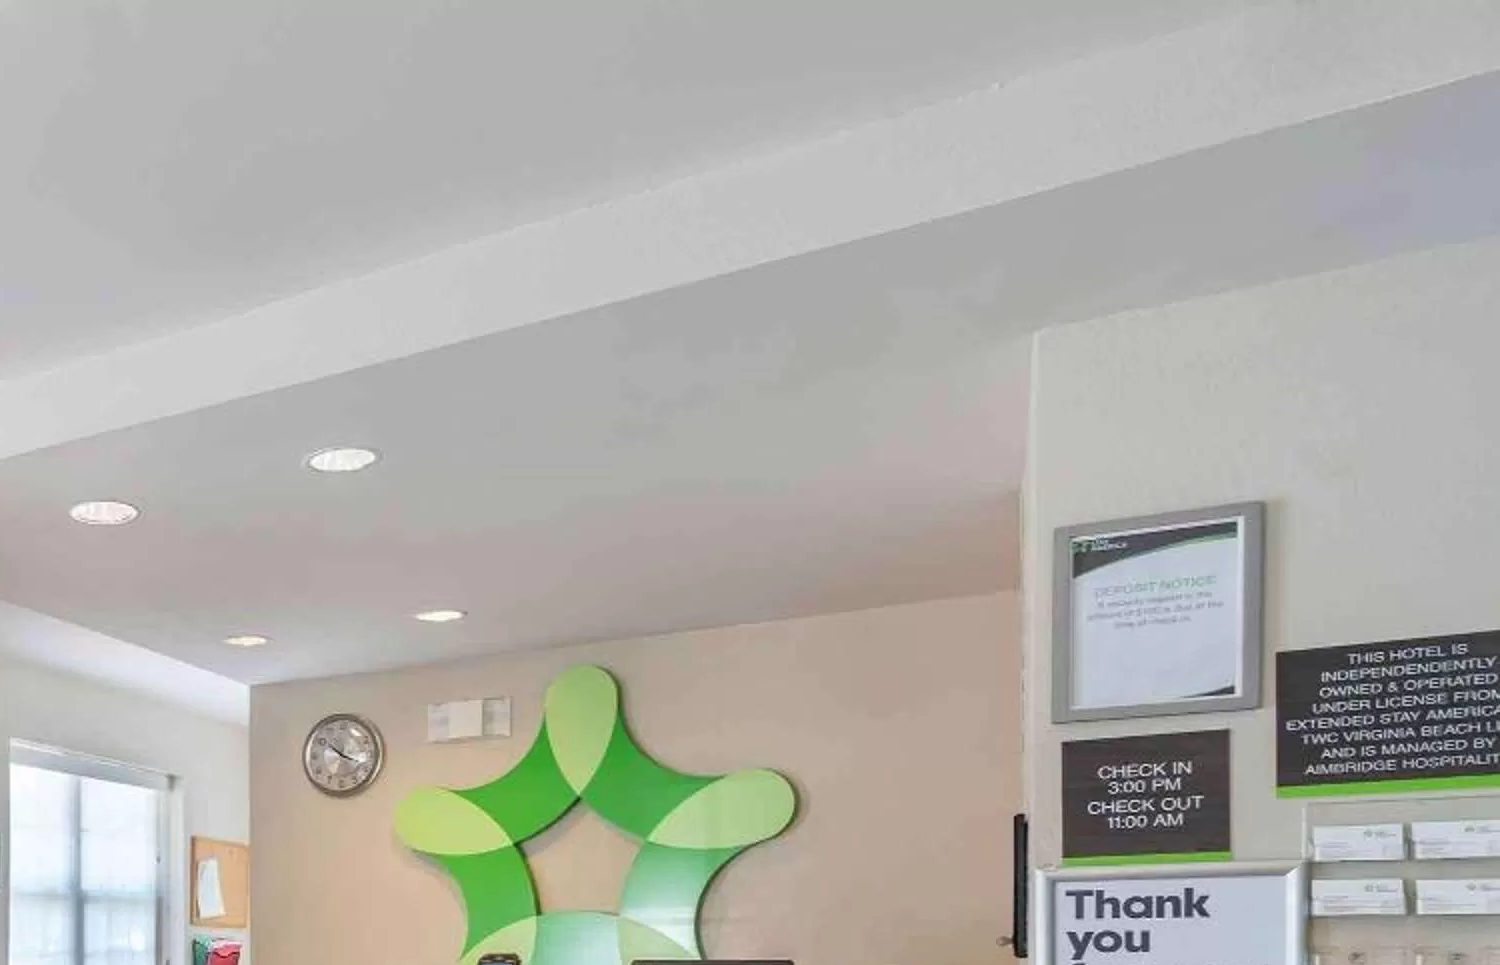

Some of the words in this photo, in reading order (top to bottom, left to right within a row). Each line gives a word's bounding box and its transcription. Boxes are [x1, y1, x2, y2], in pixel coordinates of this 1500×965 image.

[1348, 650, 1385, 665] THIS
[1389, 646, 1446, 661] HOTEL
[1451, 643, 1469, 656] IS
[1319, 683, 1383, 699] OWNED
[1387, 683, 1399, 693] &
[1403, 672, 1499, 692] OPERATED
[1312, 698, 1371, 715] UNDER
[1375, 692, 1449, 709] LICENSE
[1285, 712, 1375, 732] EXTENDED
[1379, 709, 1421, 725] STAY
[1343, 725, 1416, 742] VIRGINIA
[1421, 722, 1482, 737] BEACH
[1321, 745, 1357, 759] AND
[1361, 744, 1378, 757] IS
[1381, 738, 1469, 756] MANAGED
[1473, 735, 1497, 750] BY
[1097, 762, 1166, 779] CHECK
[1173, 760, 1193, 775] IN
[1305, 758, 1398, 776] AIMBRIDGE
[1107, 780, 1146, 795] 3:00
[1152, 777, 1182, 793] PM
[1087, 797, 1155, 815] CHECK
[1161, 795, 1205, 812] OUT
[1107, 815, 1148, 829] 11:00
[1153, 812, 1184, 827] AM
[1066, 887, 1211, 920] Thank
[1067, 929, 1151, 960] you
